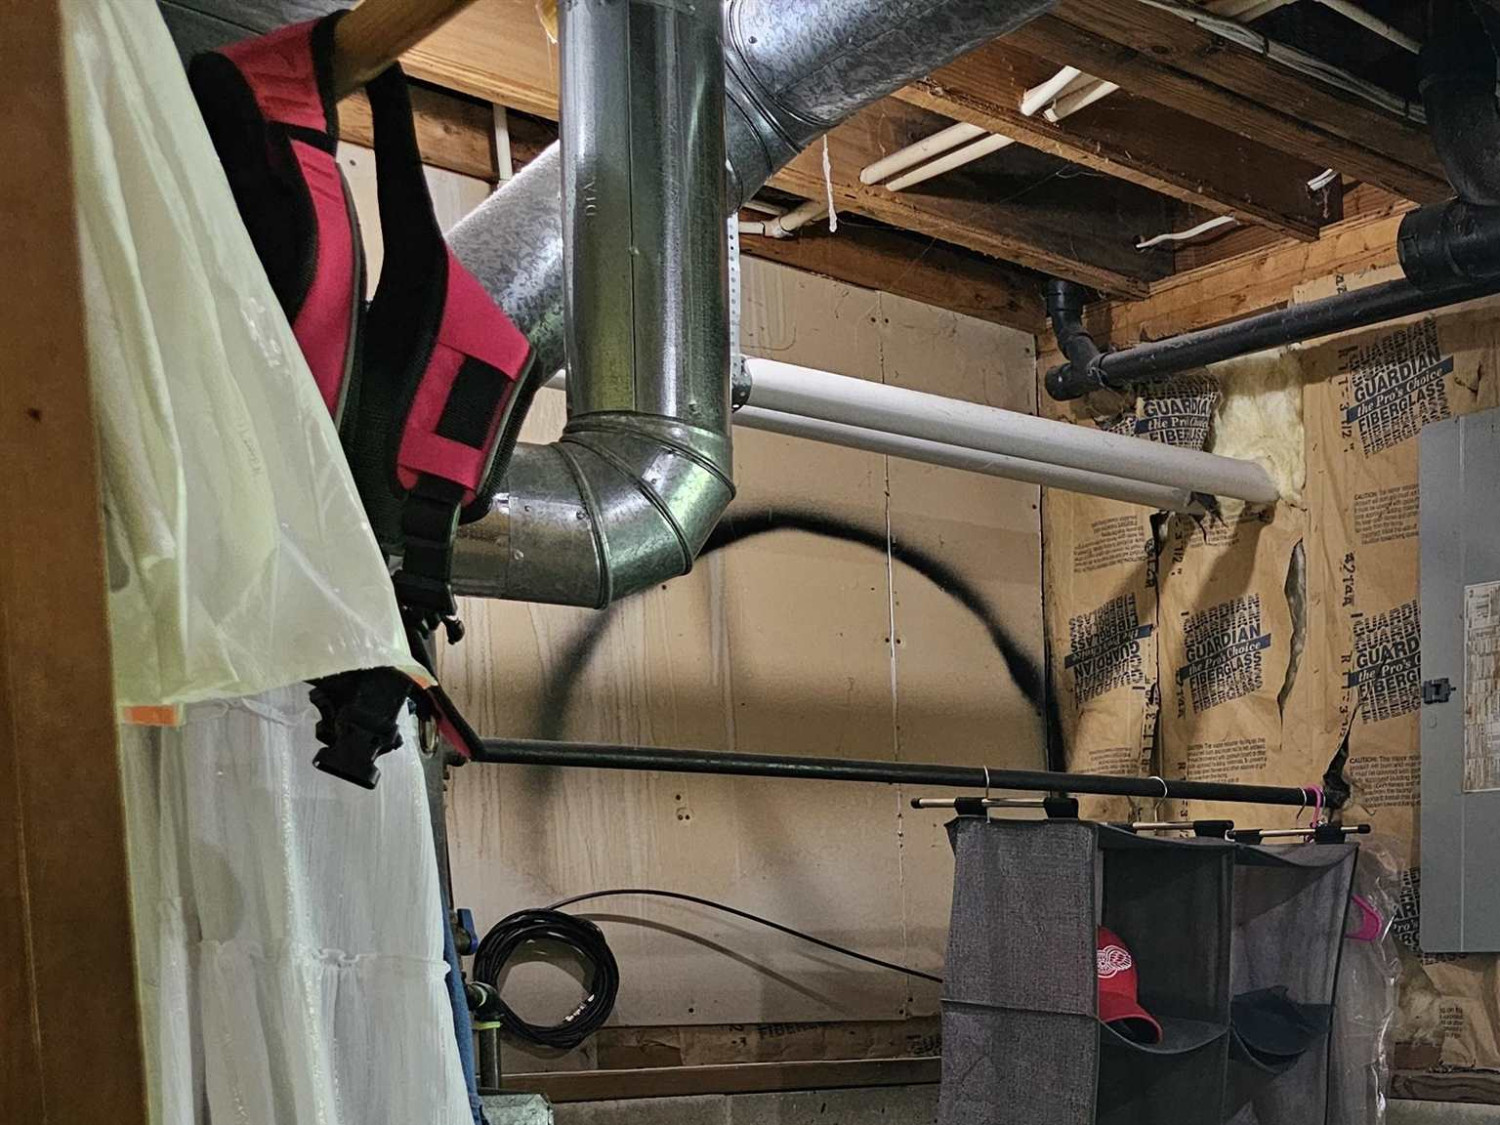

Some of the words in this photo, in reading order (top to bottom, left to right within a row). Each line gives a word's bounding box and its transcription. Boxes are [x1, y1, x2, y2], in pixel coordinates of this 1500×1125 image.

[1354, 346, 1440, 402] GUARDIAN
[1406, 369, 1443, 393] Choice
[1143, 399, 1210, 417] GUARDIA
[1359, 379, 1445, 432] FIBERGLASS
[1071, 615, 1139, 653] FIBERGLASS
[1186, 623, 1261, 663] GUARDIAN
[1227, 641, 1262, 658] Choice
[1074, 641, 1140, 678] GUARDIAN
[1190, 651, 1262, 691] FIBERGLASS
[1359, 668, 1376, 681] the
[1381, 660, 1412, 677] Pro's
